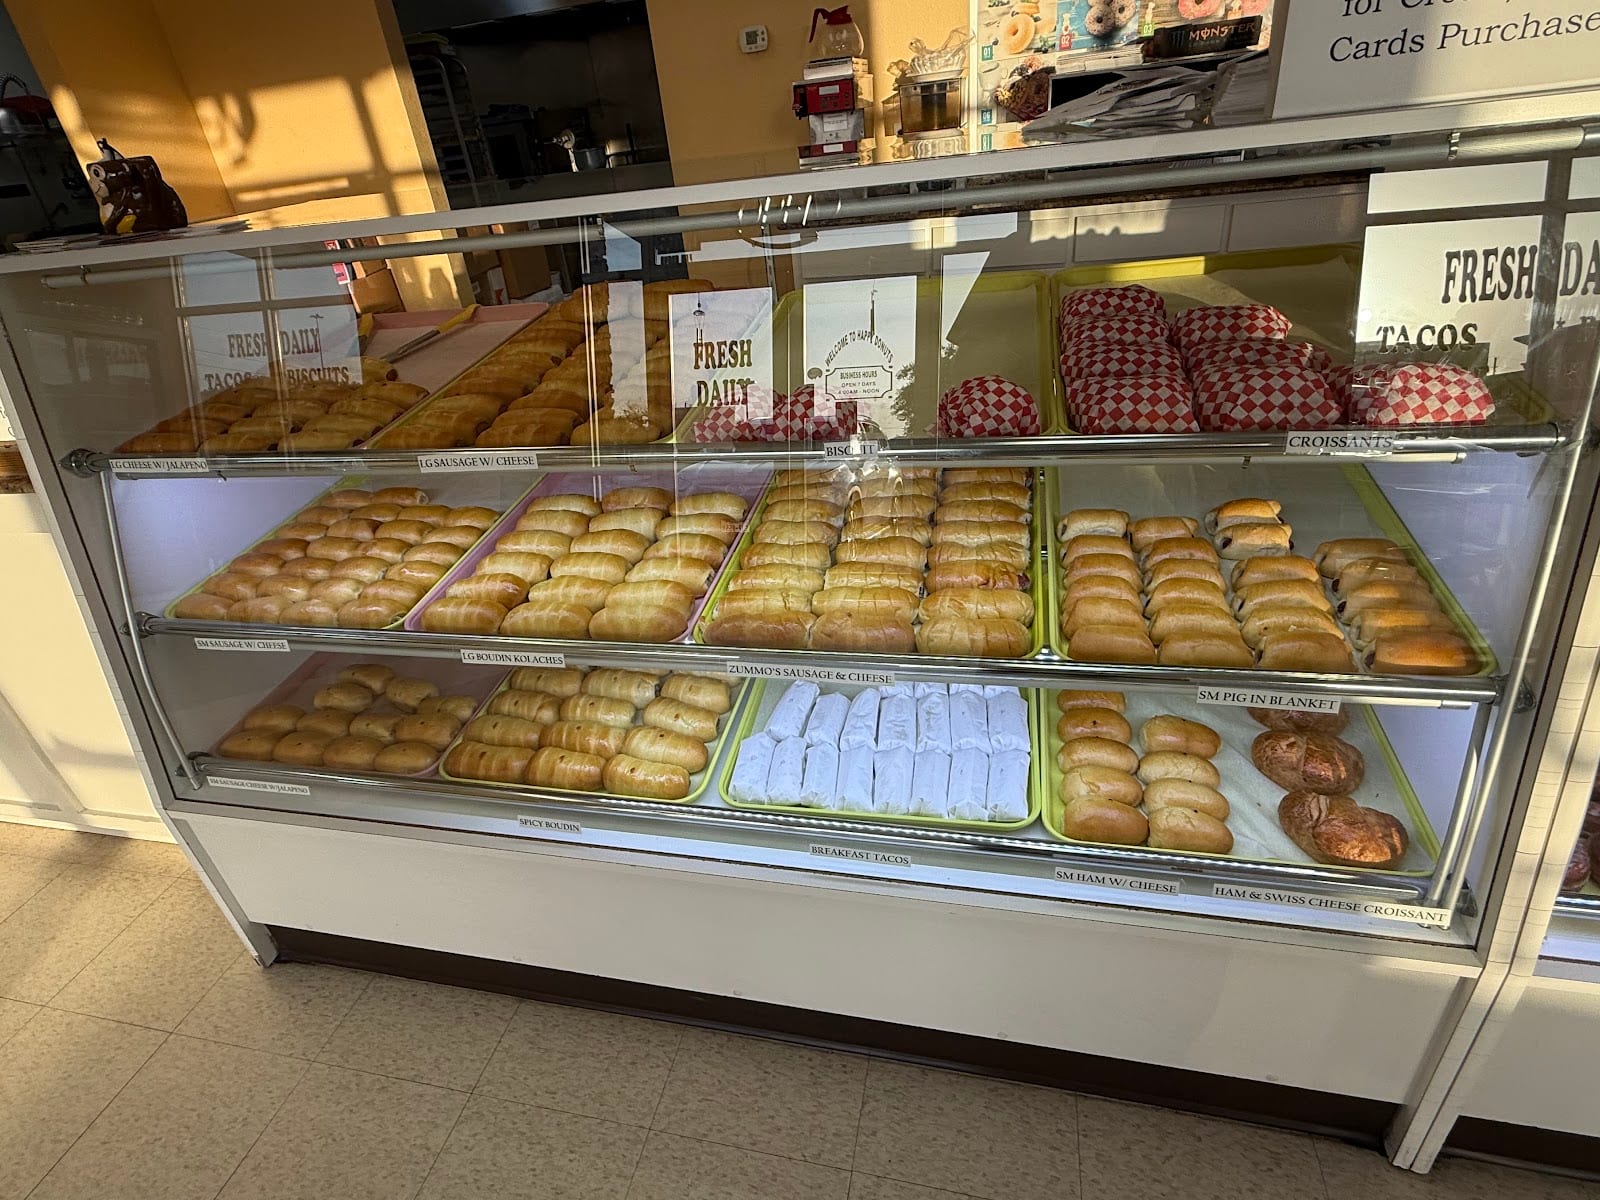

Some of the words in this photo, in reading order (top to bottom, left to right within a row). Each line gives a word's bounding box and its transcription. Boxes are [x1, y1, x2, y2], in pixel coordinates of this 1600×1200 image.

[1143, 24, 1152, 33] 03
[1329, 27, 1425, 62] Cards
[1441, 244, 1538, 304] FRESH
[281, 328, 320, 356] DAILY
[1376, 323, 1478, 354] TACOS
[693, 339, 752, 370] FRESH
[825, 334, 849, 367] WELCOME
[857, 330, 875, 344] HAPPY
[874, 335, 894, 364] DONUTS
[287, 366, 349, 386] BISCUITS
[840, 371, 861, 380] BUSINESS
[862, 370, 877, 379] HOURS
[696, 378, 753, 407] DAILY
[826, 444, 875, 456] BISCIT
[1289, 436, 1393, 448] CROISSANTS
[123, 461, 152, 469] CHEESE
[165, 461, 207, 471] JALAPENO
[420, 459, 433, 468] LG
[434, 457, 479, 467] SAUSAGE
[480, 456, 494, 466] W/
[496, 456, 535, 466] CHEESE
[209, 640, 243, 648] SAUSAGE
[257, 641, 286, 649] CHEESE
[463, 652, 475, 660] LG
[476, 653, 512, 662] BOUDIN
[513, 654, 563, 664] KOLACHES
[729, 665, 781, 676] ZUMMO'S
[783, 668, 834, 679] SAUSAGE
[835, 672, 846, 680] &
[848, 673, 892, 684] CHEESE
[1199, 690, 1220, 700] SM
[1223, 692, 1247, 702] PIG
[1250, 694, 1266, 704] IN
[1269, 696, 1338, 710] BLANKET
[520, 818, 543, 827] SPICY
[545, 821, 579, 831] BOUDIN
[812, 846, 870, 860] BREAKFAST
[874, 853, 909, 864] TACOS
[1056, 871, 1074, 880] SM
[1077, 873, 1105, 884] HAM
[1109, 877, 1127, 887] W/
[1129, 880, 1176, 893] CHEESE
[1215, 887, 1246, 898] HAM
[1249, 891, 1262, 900] &
[1264, 891, 1305, 905] SWISS
[1308, 898, 1361, 912] CHEESE
[1364, 904, 1448, 922] CROISSANT
